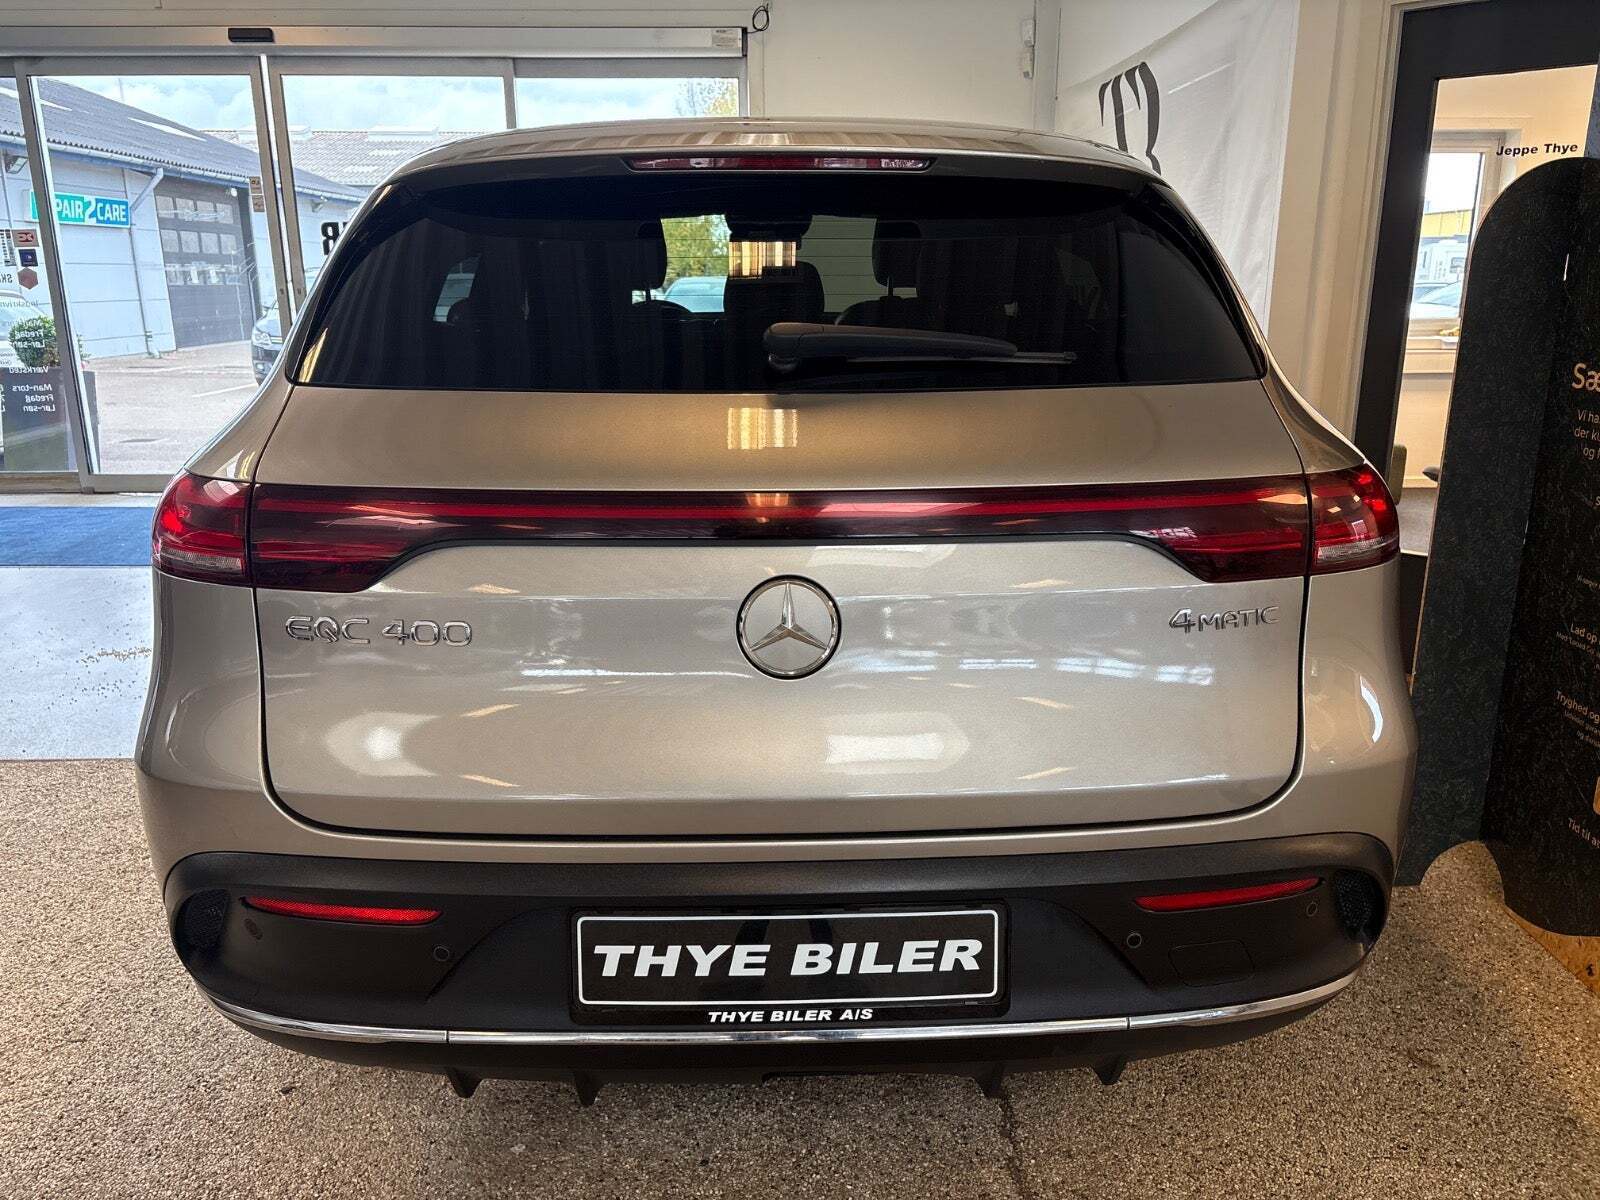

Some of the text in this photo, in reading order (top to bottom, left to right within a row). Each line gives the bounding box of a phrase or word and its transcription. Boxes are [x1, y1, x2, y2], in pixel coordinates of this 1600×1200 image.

[1496, 143, 1578, 157] Jeppe Thye
[1577, 409, 1586, 421] Vi
[1583, 447, 1595, 460] og
[285, 616, 473, 646] EQC 400
[1587, 632, 1597, 645] op
[1556, 690, 1589, 715] Tryghed
[593, 939, 983, 977] THYE BILER
[708, 1011, 765, 1023] THYE
[770, 1009, 833, 1022] BILER
